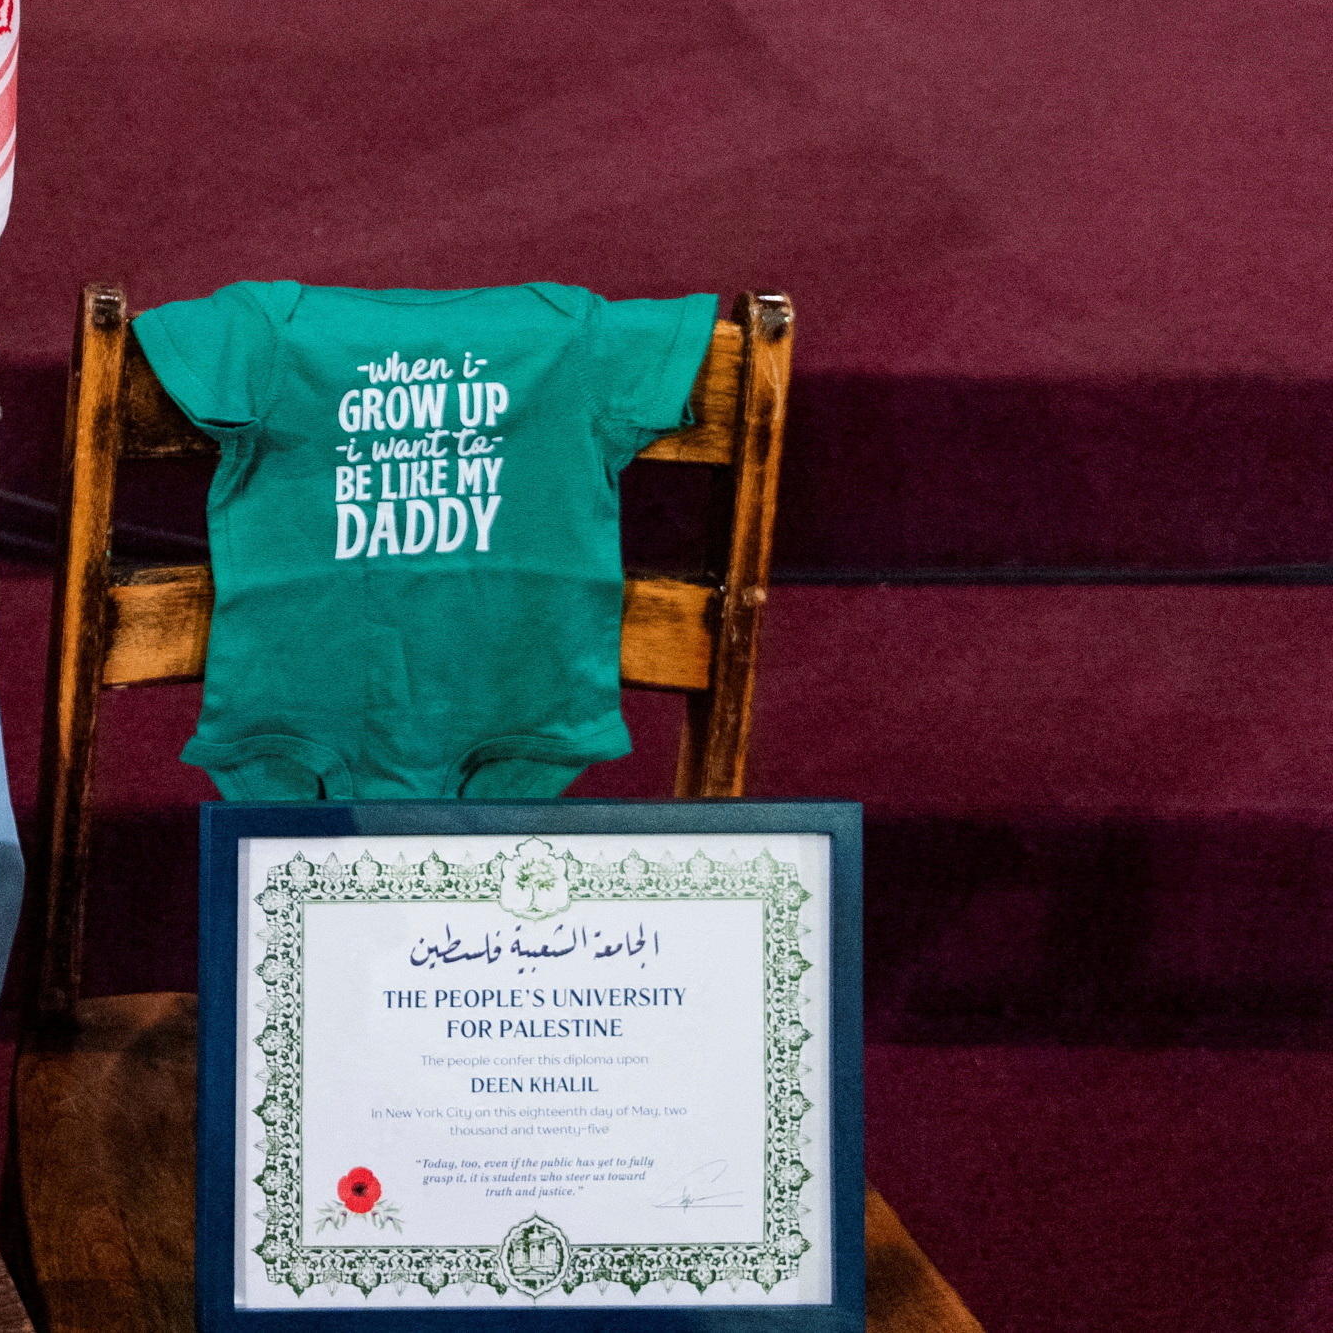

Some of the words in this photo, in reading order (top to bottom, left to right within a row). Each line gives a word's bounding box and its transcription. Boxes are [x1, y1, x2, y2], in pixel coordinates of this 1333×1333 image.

[338, 384, 448, 434] GROW
[458, 381, 509, 428] UP
[371, 428, 449, 462] want
[334, 463, 372, 504] BE
[381, 458, 447, 502] LIKE
[455, 457, 502, 496] MY
[334, 495, 502, 560] DADDY
[409, 923, 502, 969] فلسطين
[509, 923, 587, 974] الشعبية
[593, 922, 659, 969] الجامعة
[382, 989, 427, 1008] THE
[552, 987, 686, 1007] UNIVERSITY
[446, 1019, 492, 1039] FOR
[499, 1018, 623, 1038] PALESTINE
[420, 1054, 444, 1066] The
[447, 1055, 490, 1068] people
[492, 1054, 534, 1065] confer
[537, 1054, 560, 1065] this
[562, 1053, 613, 1067] diploma
[616, 1055, 648, 1066] upon
[470, 1076, 523, 1093] DEEN
[529, 1076, 598, 1093] KHALIL
[371, 1108, 382, 1118] In
[385, 1107, 412, 1118] New
[415, 1107, 443, 1118] York
[445, 1106, 472, 1120] City
[474, 1108, 490, 1117] on
[493, 1106, 516, 1117] this
[518, 1105, 587, 1119] eighteenth
[589, 1106, 613, 1118] day
[615, 1105, 628, 1116] of
[631, 1105, 660, 1118] May,
[663, 1106, 686, 1115] two
[449, 1124, 507, 1135] thousand
[510, 1124, 534, 1135] and
[536, 1123, 609, 1136] twenty-five
[460, 1159, 481, 1169] too,
[483, 1160, 508, 1168] even
[510, 1156, 520, 1170] if
[520, 1157, 538, 1167] the
[539, 1156, 573, 1170] public
[575, 1156, 595, 1167] has
[597, 1157, 613, 1169] yet
[615, 1157, 626, 1166] to
[626, 1155, 653, 1168] fully
[421, 1175, 453, 1186] grasp
[455, 1172, 467, 1183] it,
[469, 1172, 478, 1182] it
[479, 1172, 489, 1182] is
[491, 1171, 536, 1182] students
[539, 1171, 562, 1182] who
[564, 1172, 591, 1181] steer
[592, 1173, 605, 1181] us
[607, 1170, 646, 1181] toward
[484, 1186, 512, 1197] truth
[514, 1185, 536, 1196] and
